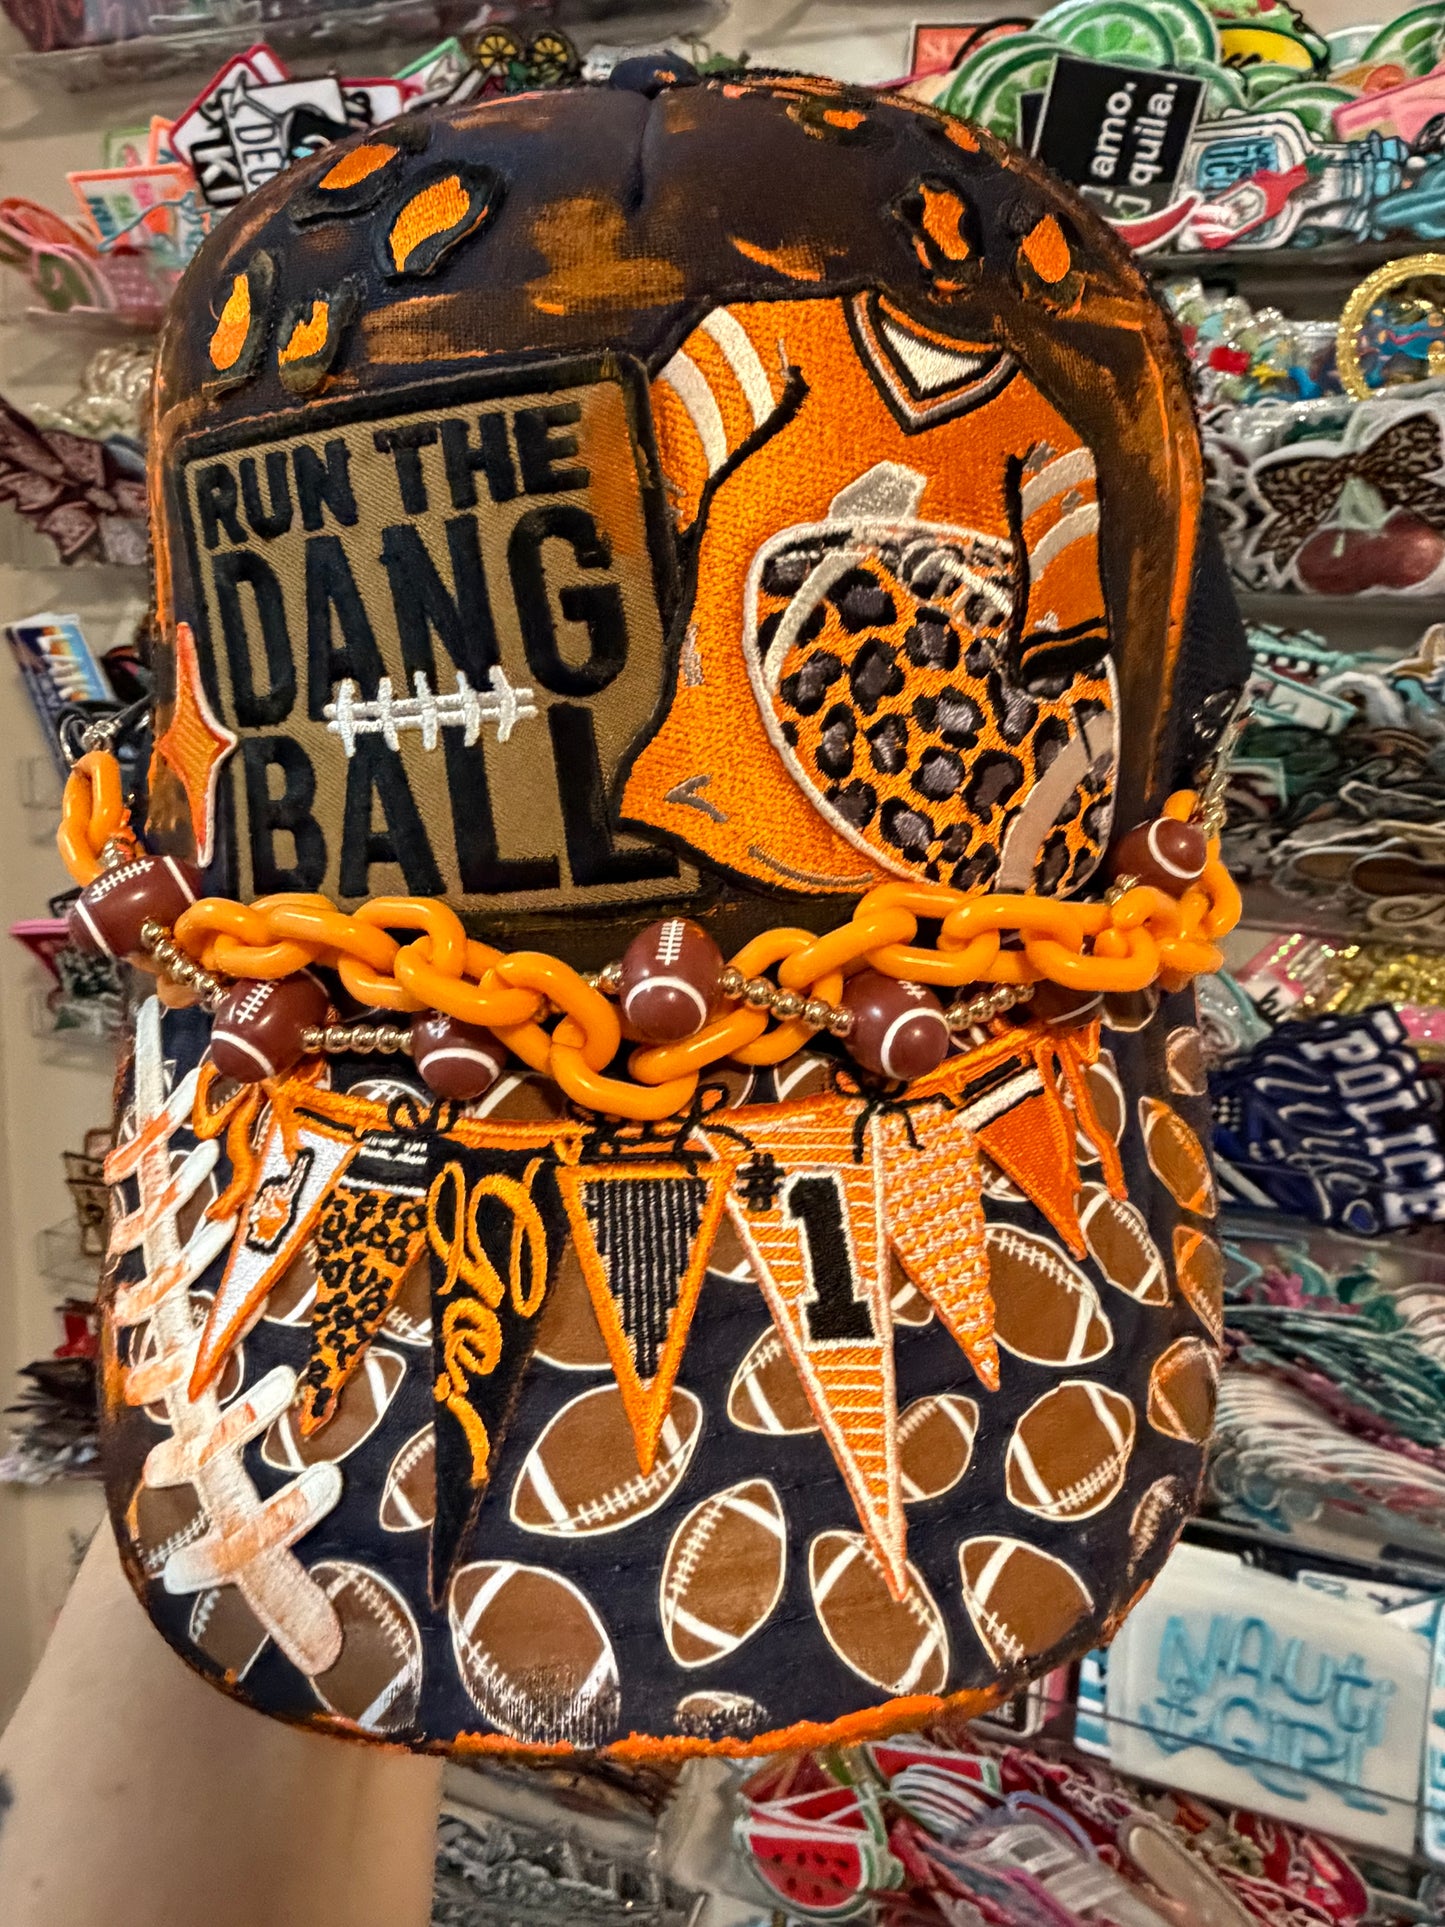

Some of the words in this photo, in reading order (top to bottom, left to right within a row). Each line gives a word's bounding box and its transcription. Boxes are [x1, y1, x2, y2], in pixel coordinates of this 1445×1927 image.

[1090, 82, 1137, 178] amo.
[1128, 83, 1178, 186] quila.
[195, 438, 359, 549] RUN
[374, 402, 590, 514] THE
[211, 504, 630, 727] DANG
[245, 702, 680, 898] BALL
[1299, 1029, 1445, 1227] POLICE
[736, 1153, 878, 1345] #1
